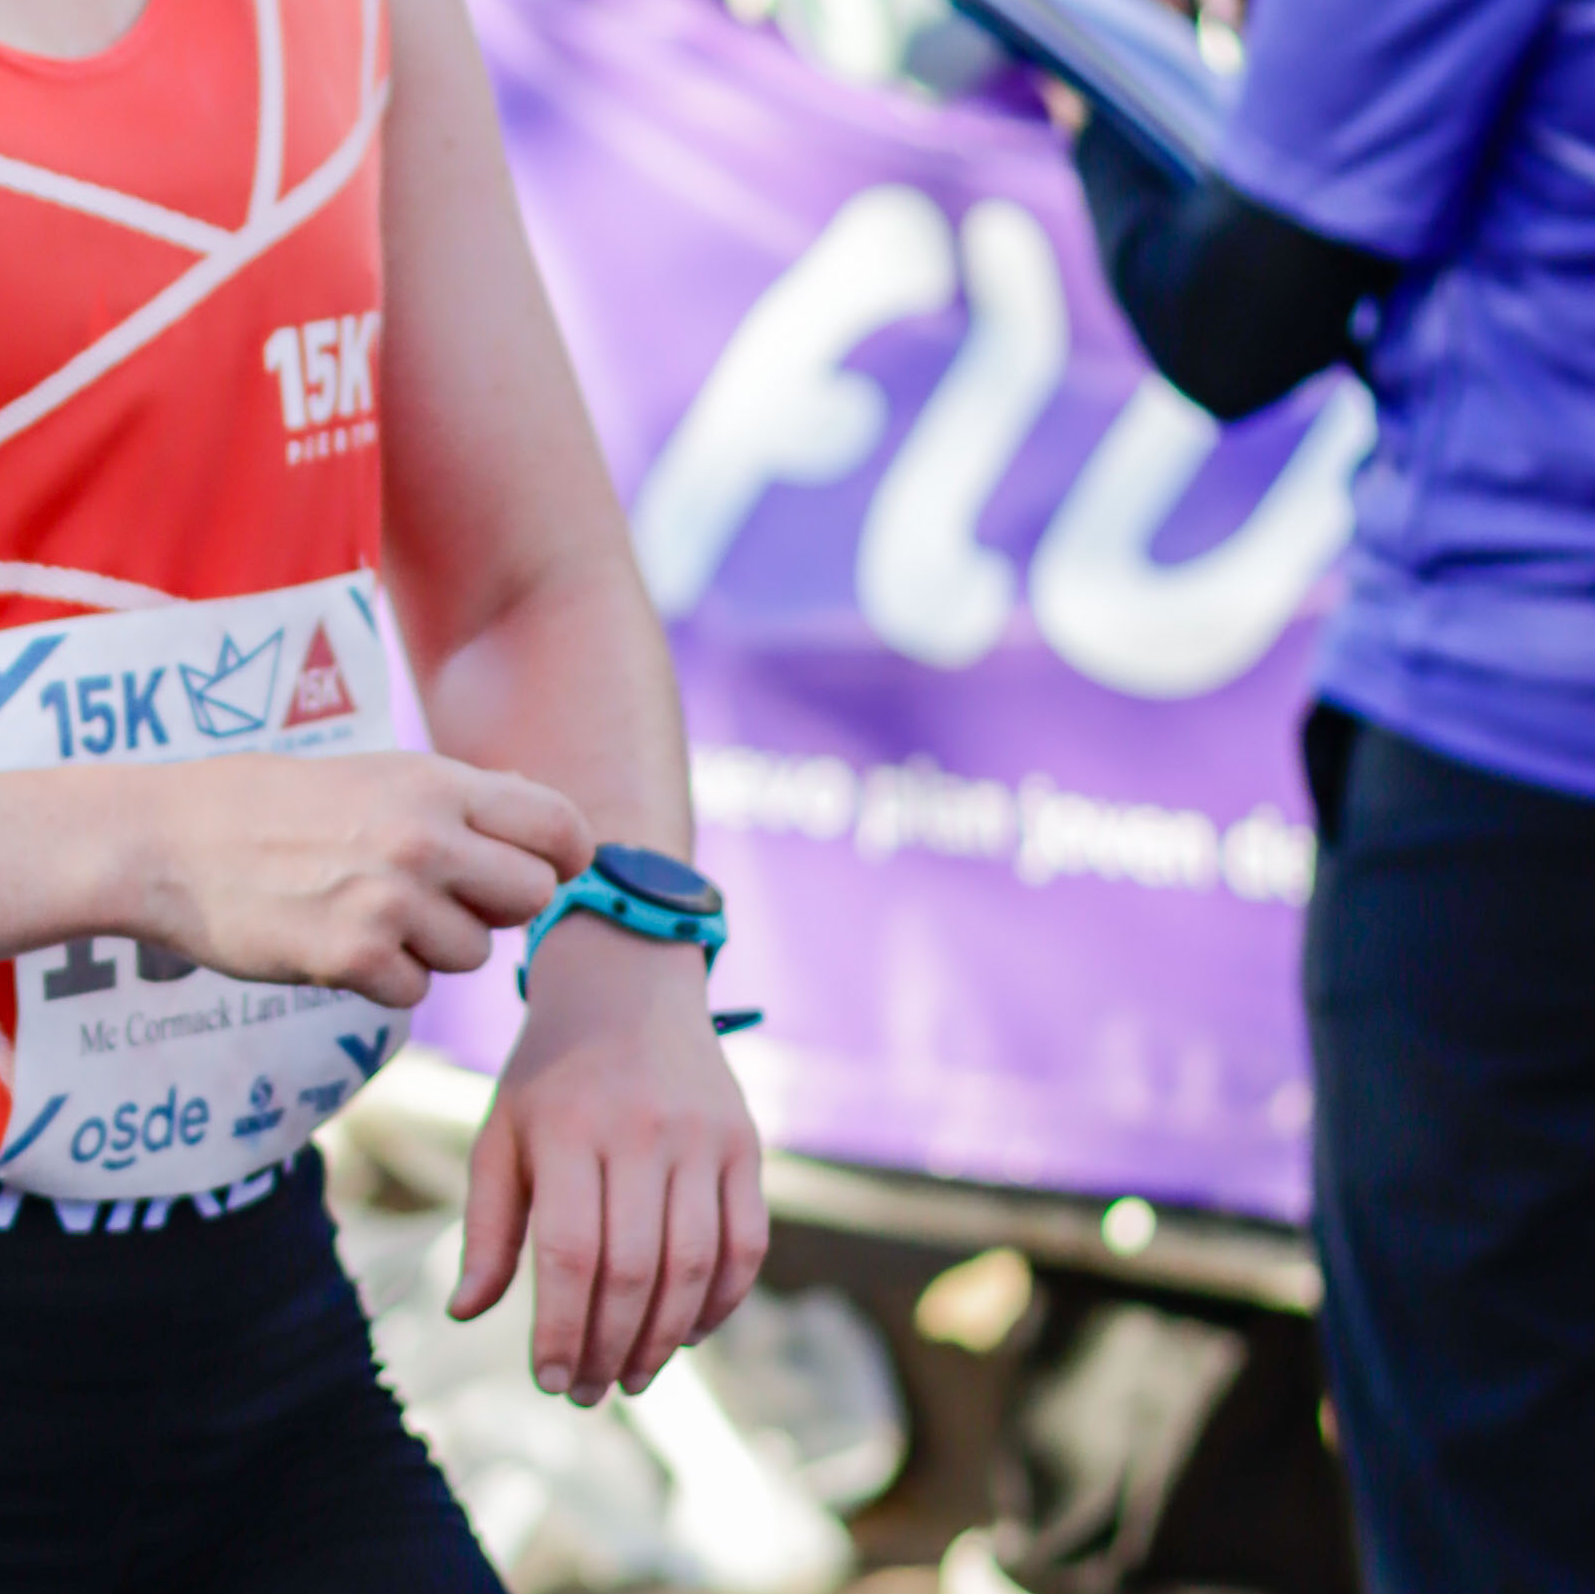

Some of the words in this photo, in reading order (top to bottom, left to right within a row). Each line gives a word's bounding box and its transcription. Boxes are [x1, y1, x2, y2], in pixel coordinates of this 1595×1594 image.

[262, 310, 383, 432] 15K
[39, 666, 171, 760] 15K
[1016, 773, 1214, 887] joven
[79, 1019, 118, 1055] Mc
[125, 996, 233, 1047] Cormack
[70, 1083, 210, 1165] osde
